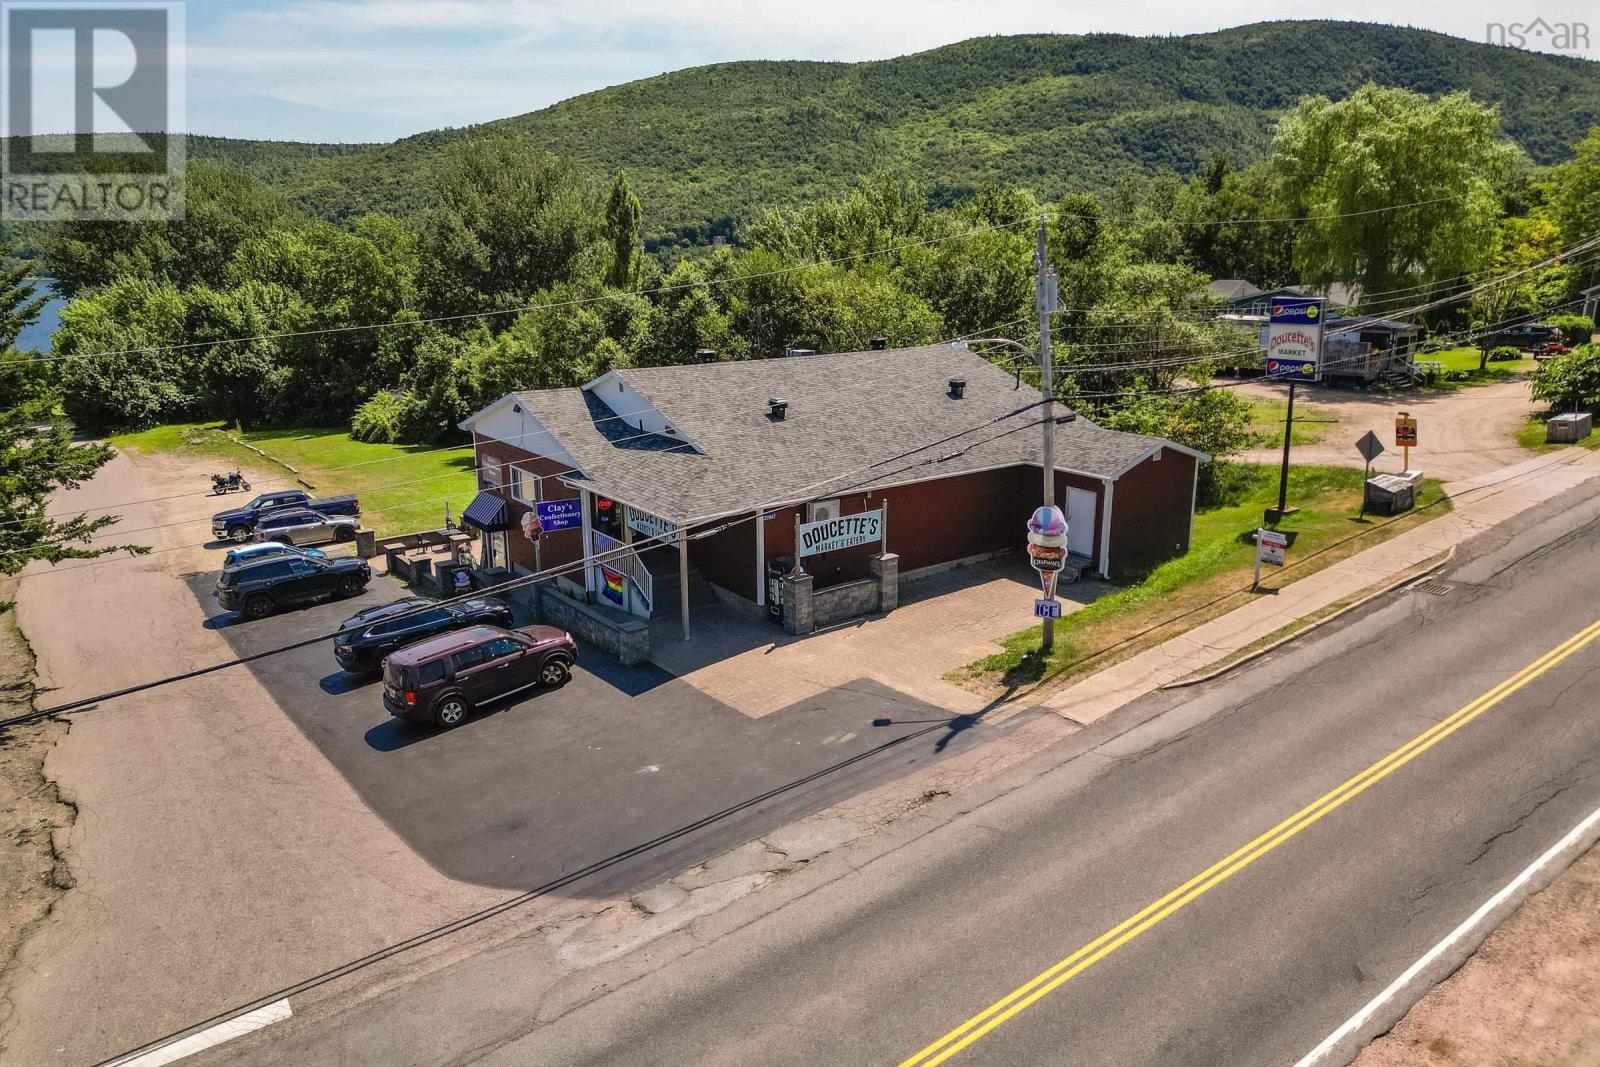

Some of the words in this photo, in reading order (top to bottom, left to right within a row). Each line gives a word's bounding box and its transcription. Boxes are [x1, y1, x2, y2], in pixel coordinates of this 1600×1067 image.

[1278, 349, 1306, 357] MARKET
[547, 502, 573, 513] Clay's
[539, 511, 581, 521] Confectionery
[802, 517, 879, 549] DOUCETTE'S
[815, 540, 839, 553] MARKET
[1036, 603, 1058, 617] ICE
